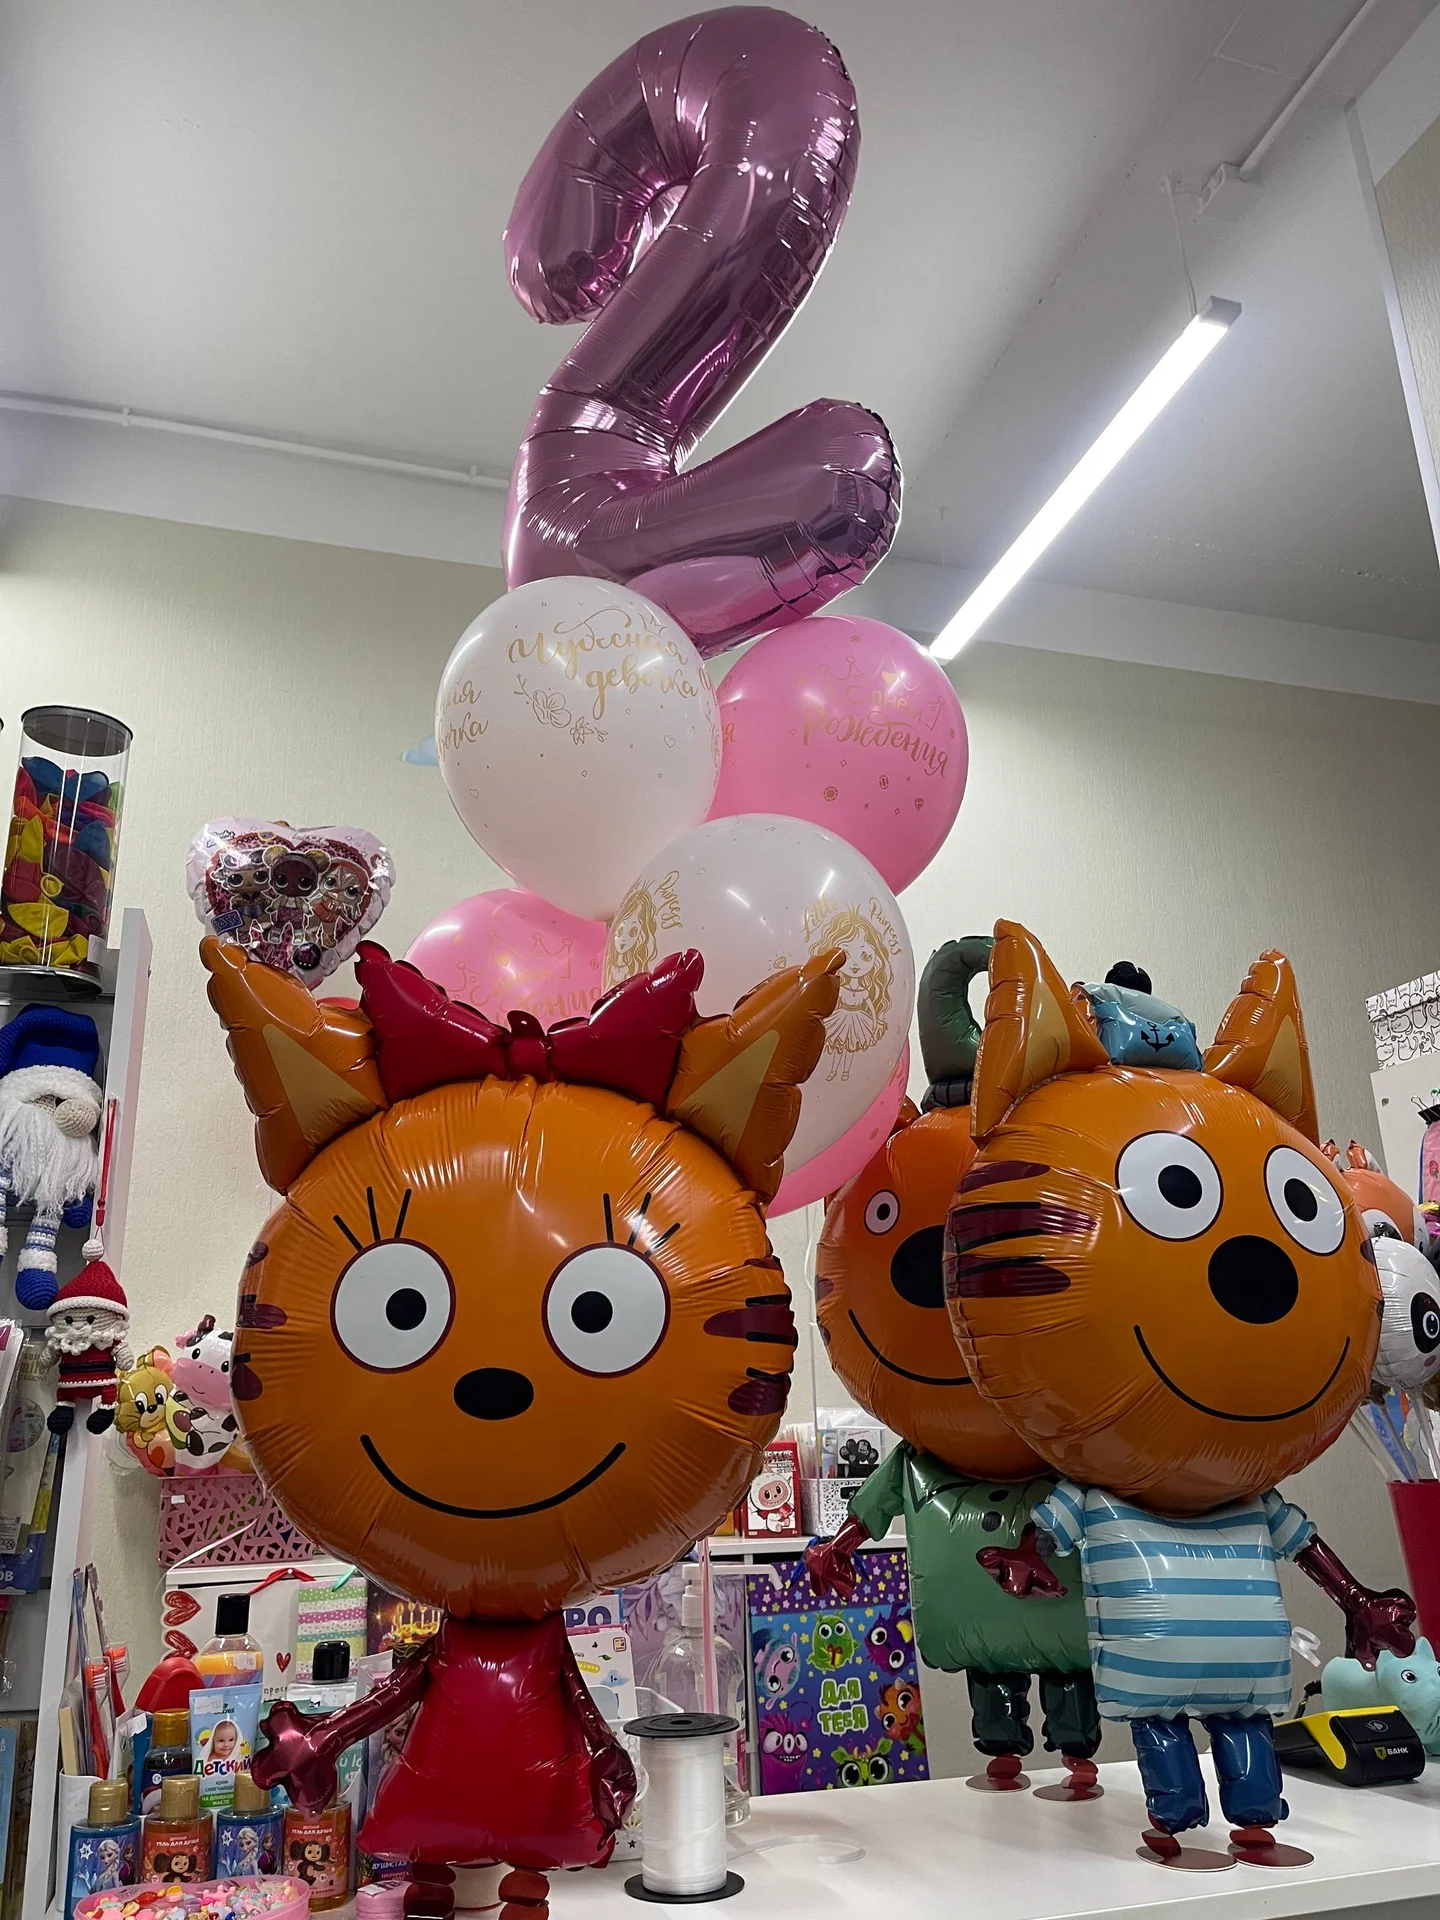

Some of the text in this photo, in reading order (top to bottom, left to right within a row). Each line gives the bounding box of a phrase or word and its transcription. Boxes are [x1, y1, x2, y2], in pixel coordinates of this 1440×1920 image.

[586, 654, 698, 720] девочка
[818, 1706, 868, 1734] ТЕБЯ
[1387, 1747, 1409, 1755] БАНК
[193, 1755, 252, 1778] Детский
